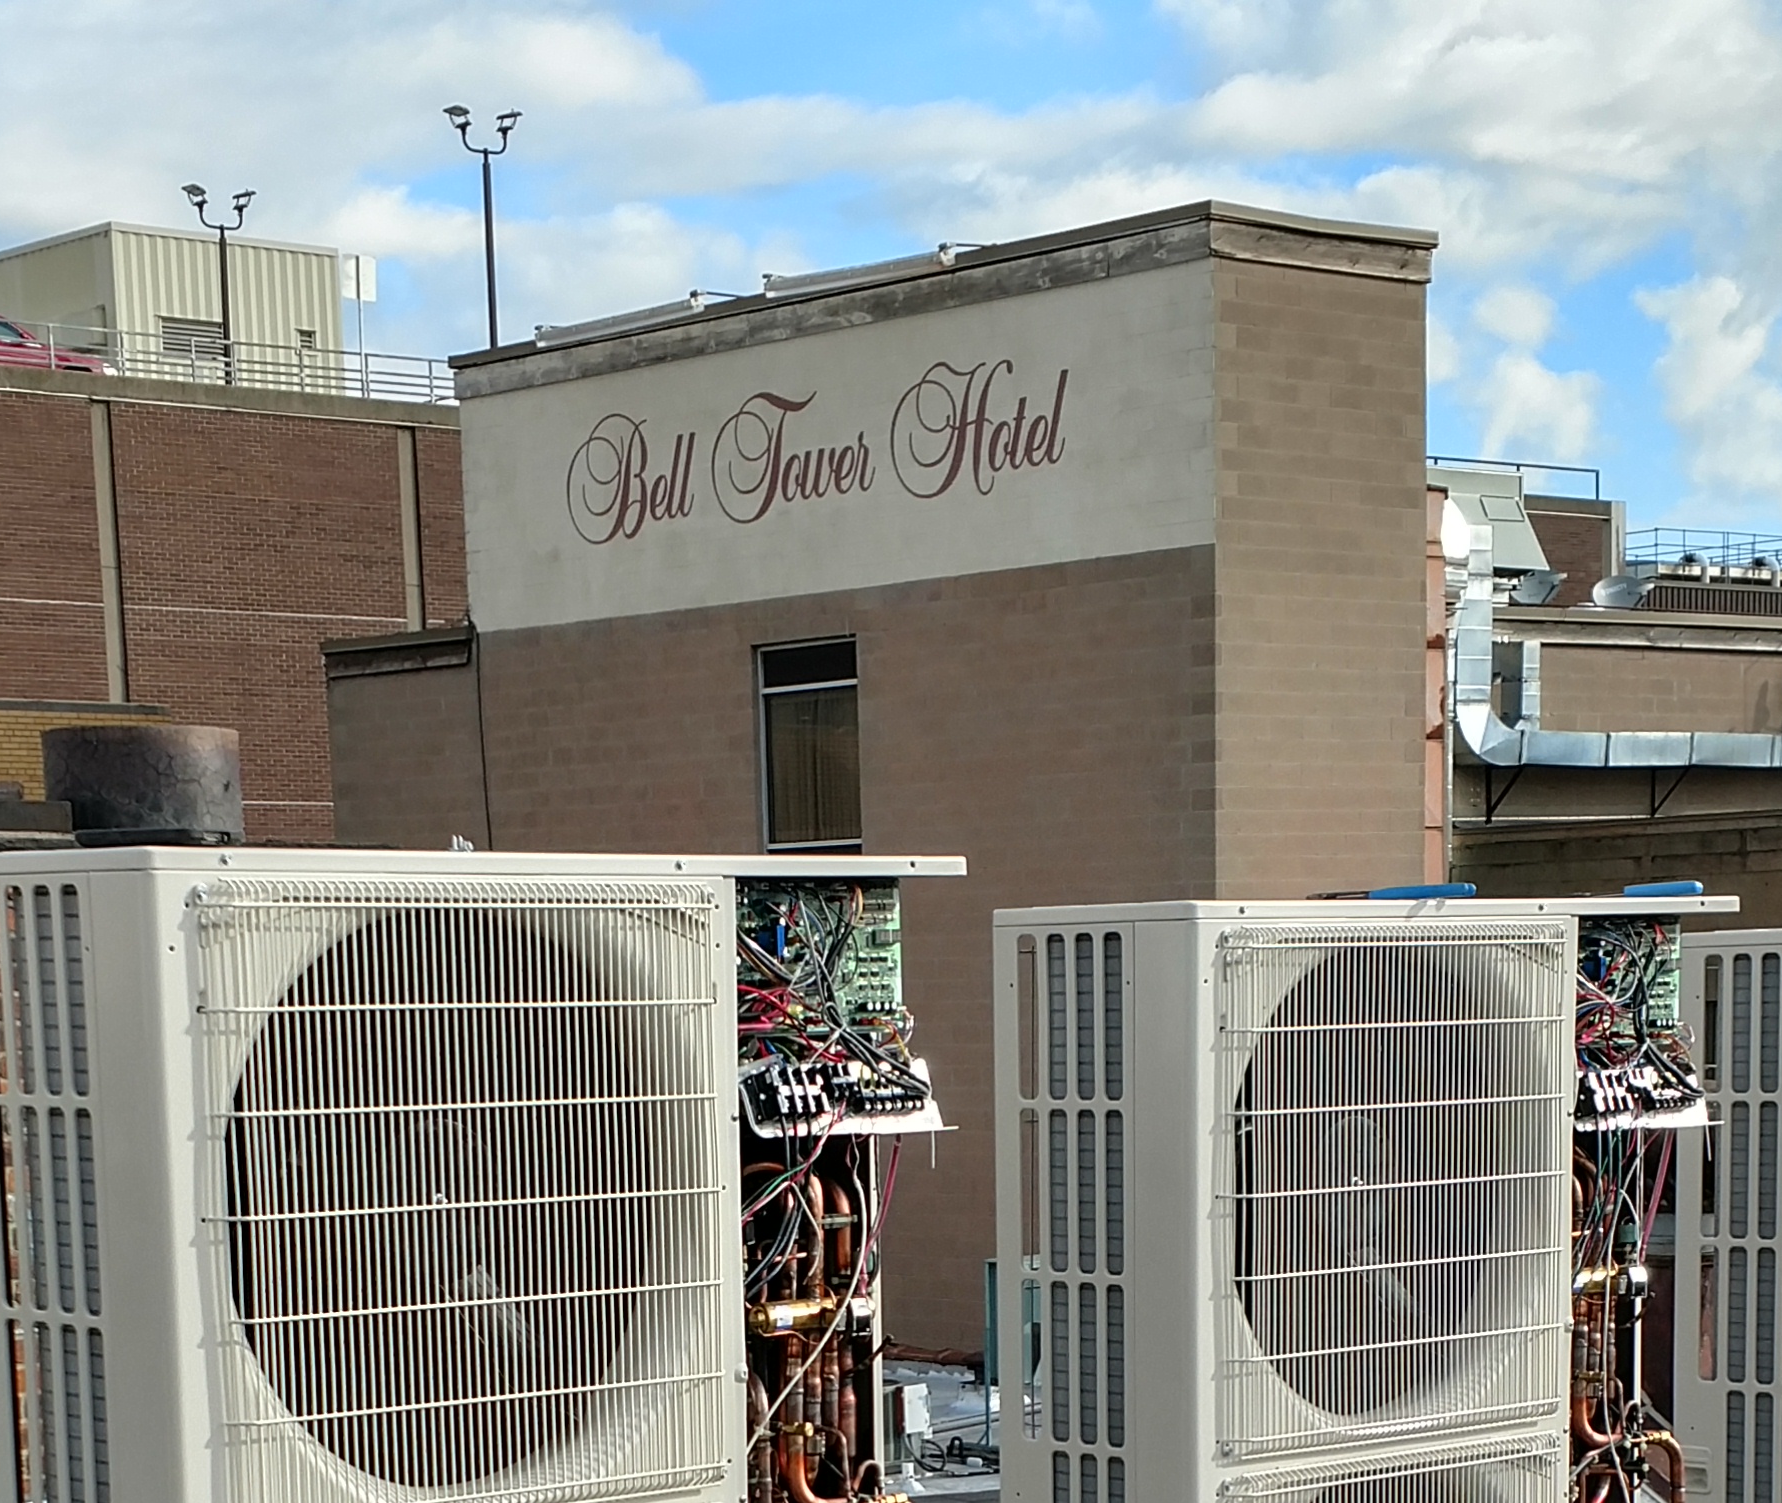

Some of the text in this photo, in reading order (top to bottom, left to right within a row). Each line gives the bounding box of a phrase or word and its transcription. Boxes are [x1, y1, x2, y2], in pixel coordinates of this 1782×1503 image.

[567, 359, 1069, 545] Bell Tower Hotel
